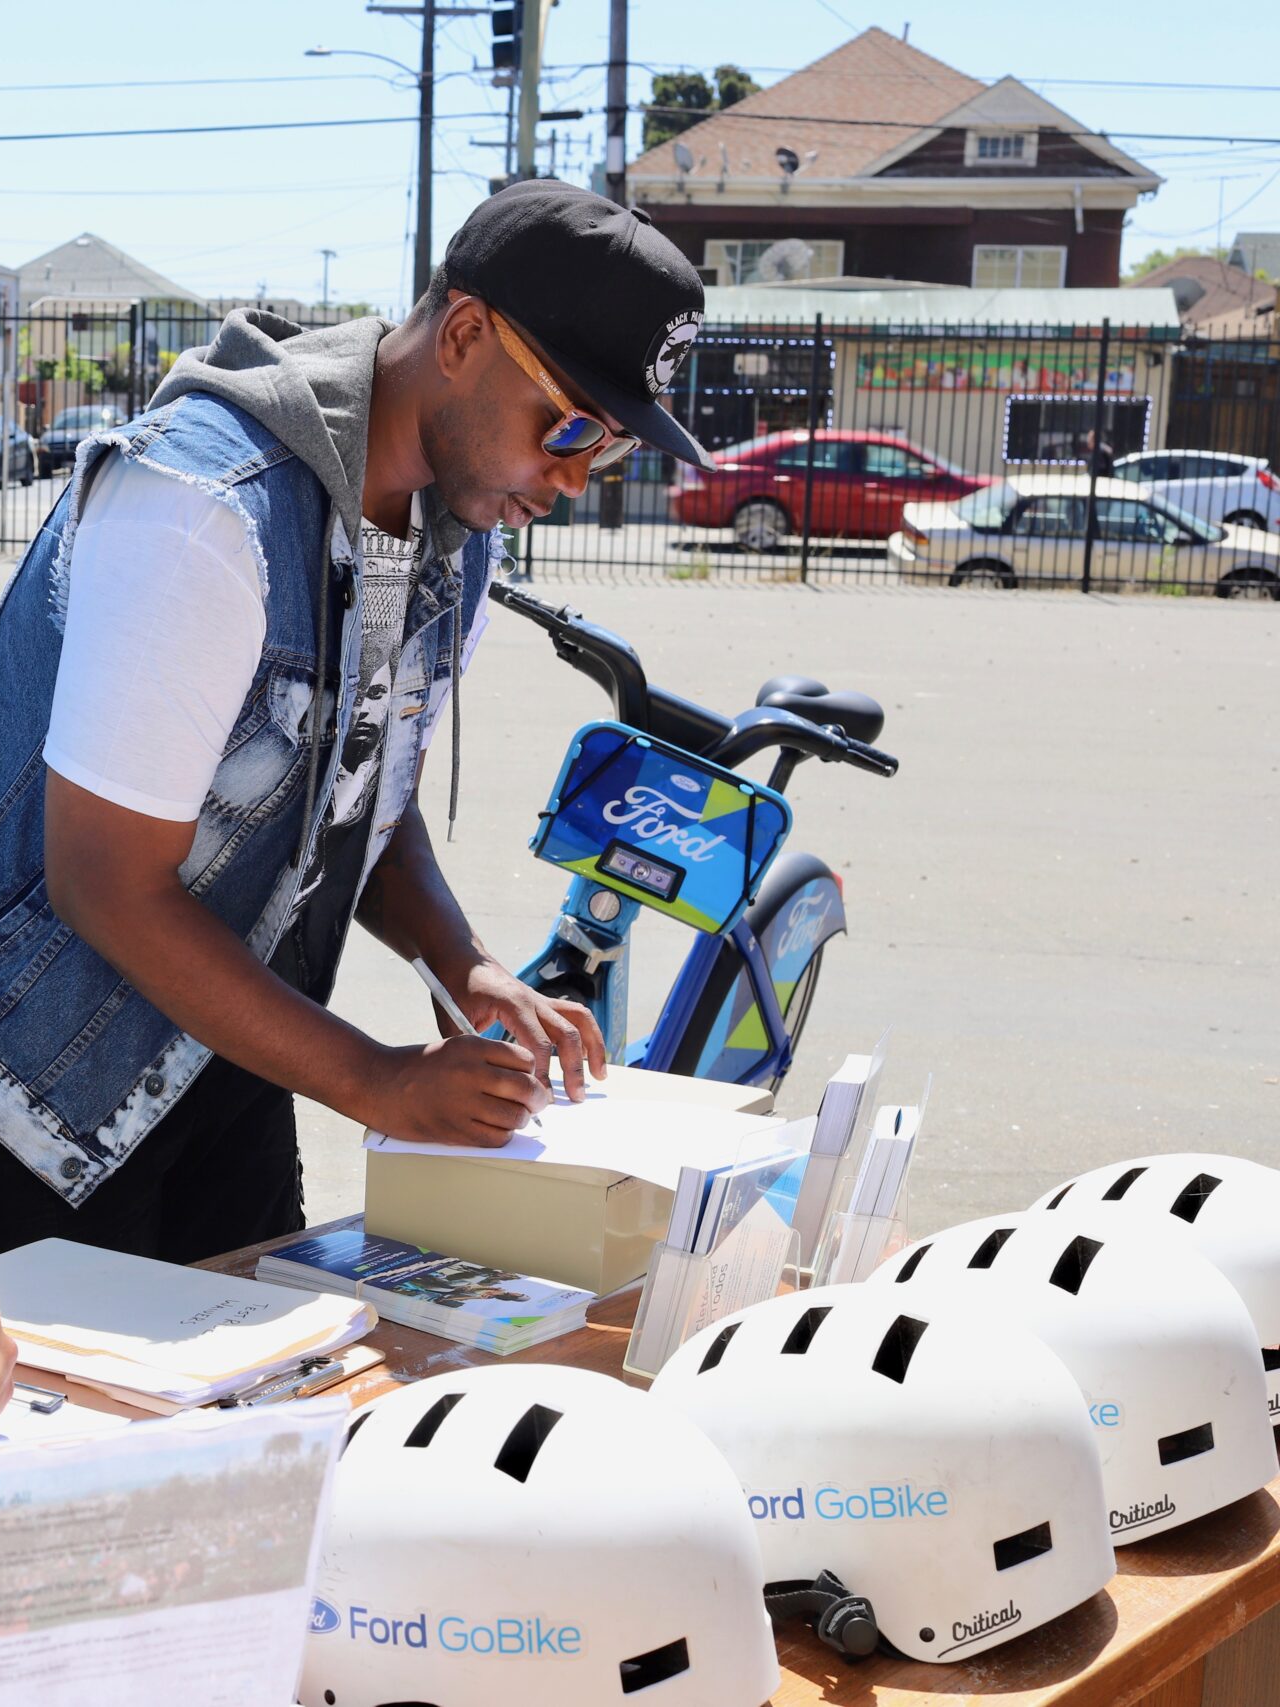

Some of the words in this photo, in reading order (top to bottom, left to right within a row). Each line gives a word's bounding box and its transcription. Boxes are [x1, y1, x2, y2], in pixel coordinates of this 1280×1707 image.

[666, 312, 688, 333] BLACK
[602, 786, 726, 862] Ford
[777, 892, 833, 960] Ford
[747, 1488, 805, 1520] ord
[815, 1485, 948, 1520] GoBike
[1109, 1494, 1176, 1529] Critical
[349, 1606, 428, 1648] Ford
[438, 1616, 581, 1655] GoBike
[951, 1599, 1022, 1643] Critical
